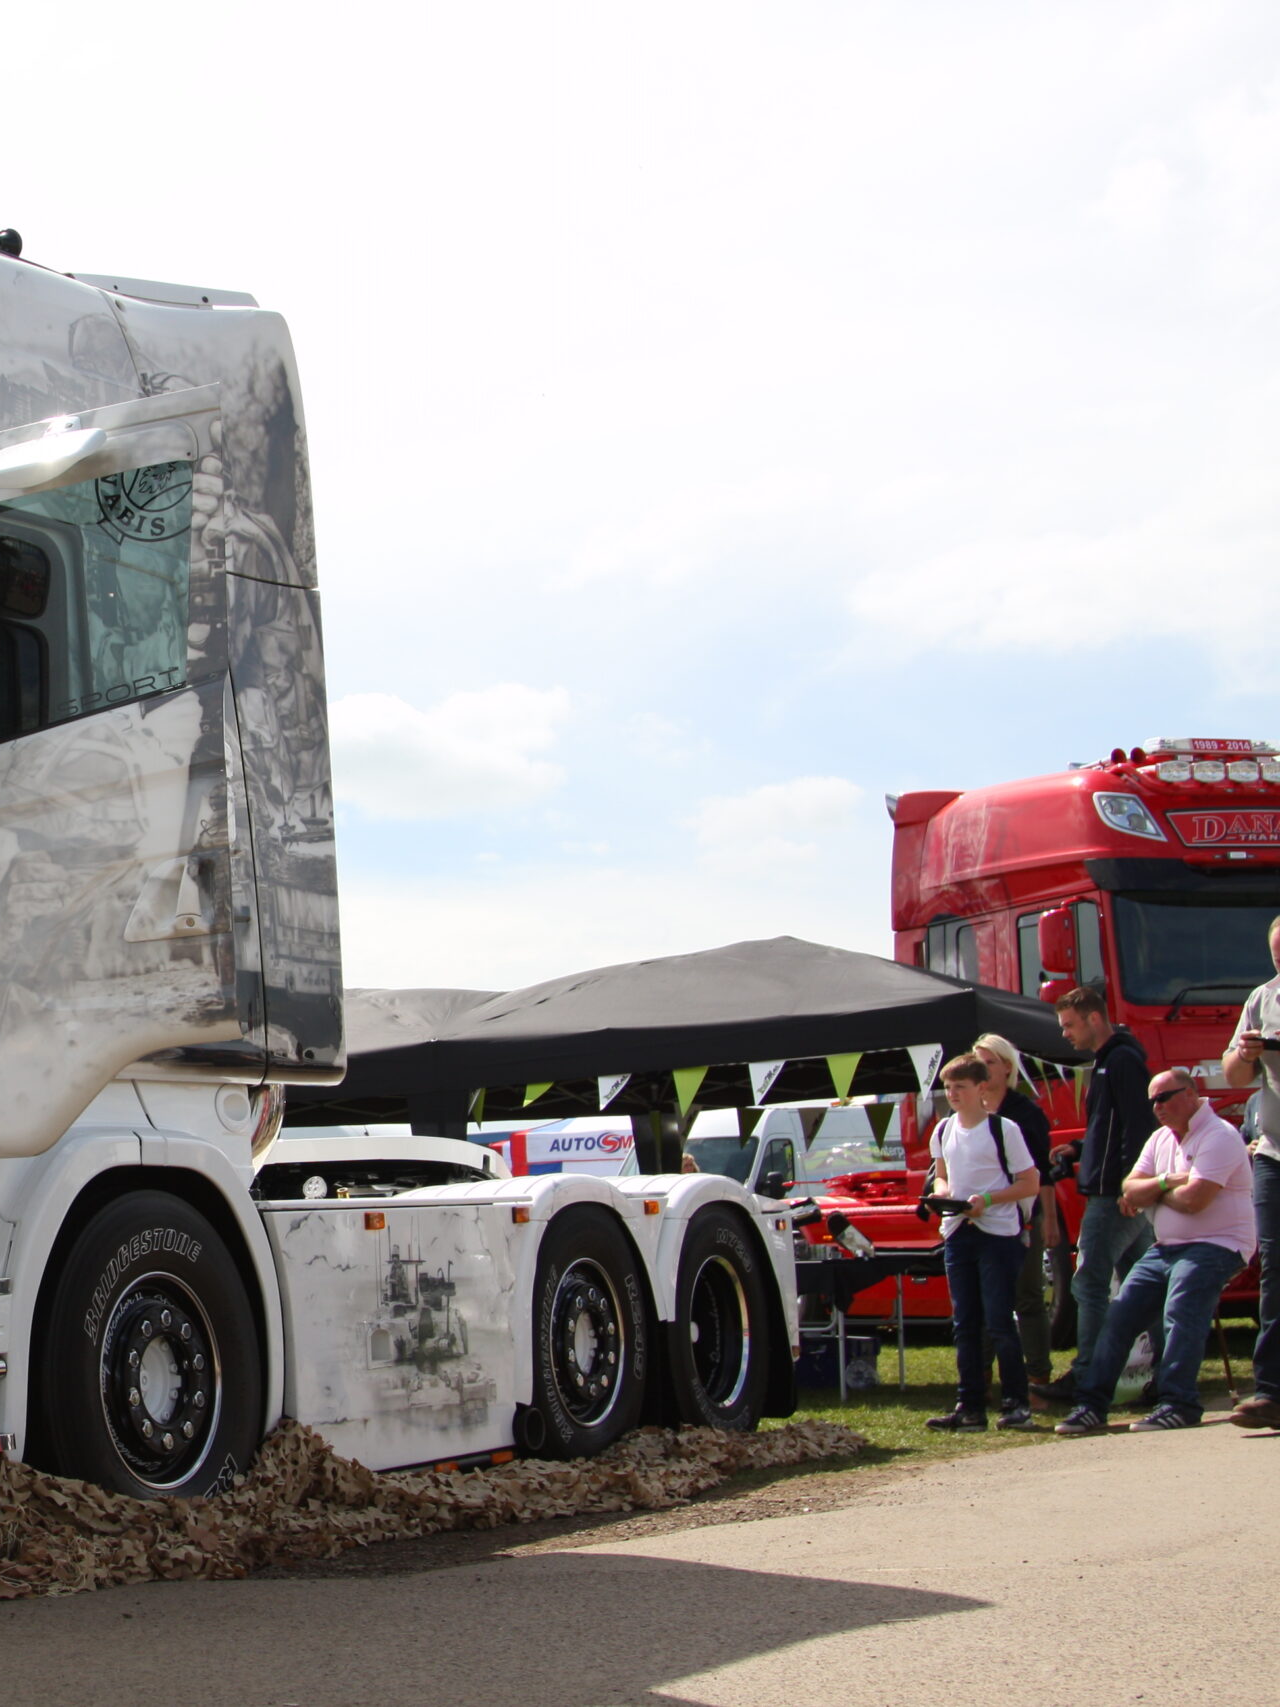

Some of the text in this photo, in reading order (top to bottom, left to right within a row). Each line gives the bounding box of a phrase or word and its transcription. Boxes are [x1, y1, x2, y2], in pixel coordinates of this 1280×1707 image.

[1193, 741, 1251, 751] 1989 2014
[1192, 814, 1280, 843] DAN
[84, 1228, 202, 1346] BRIDGESTONE
